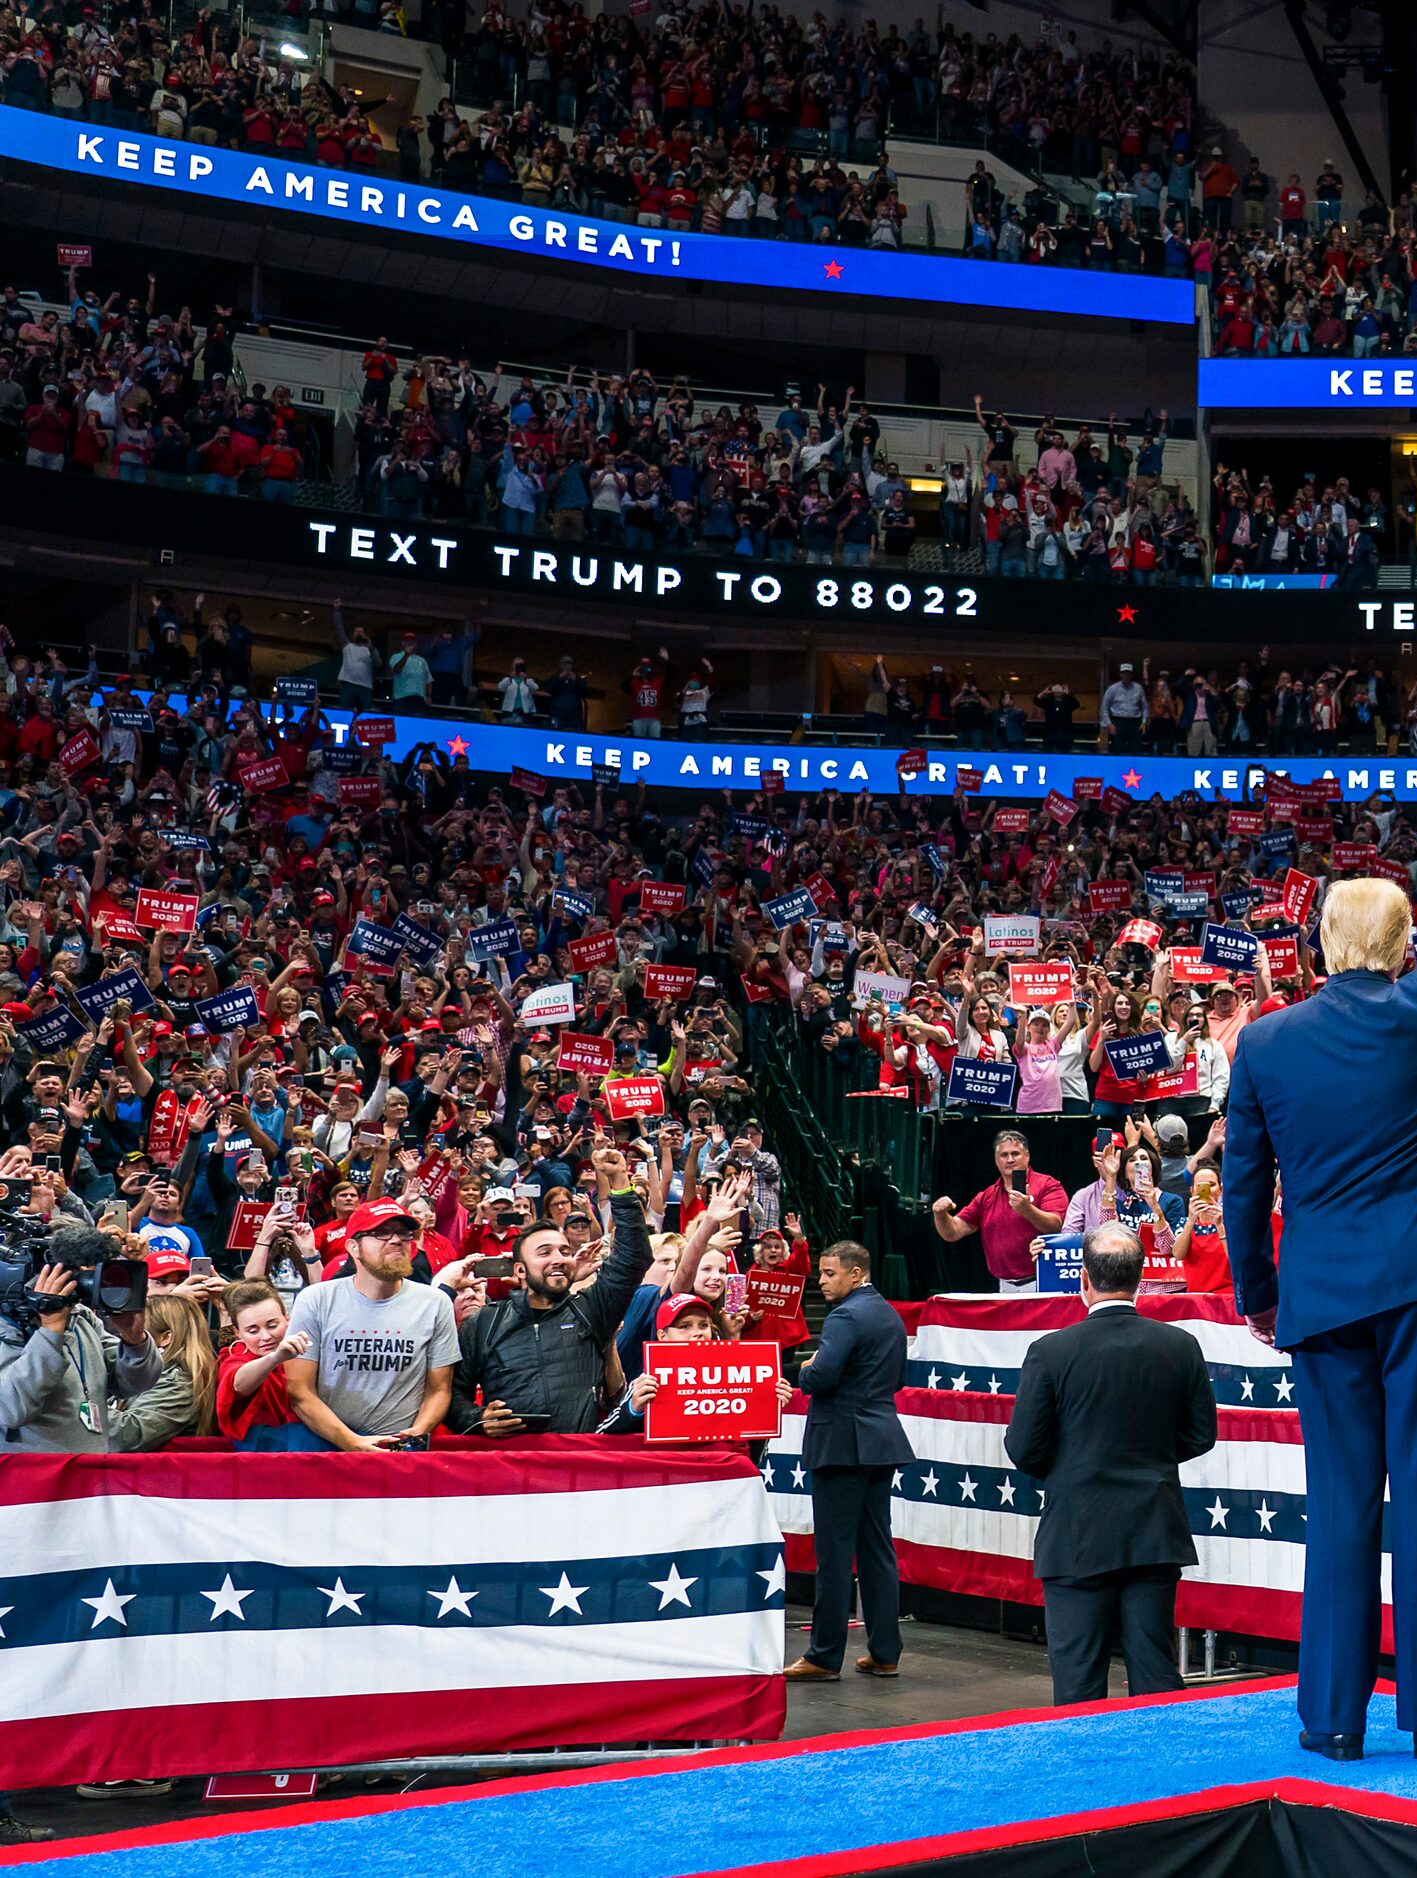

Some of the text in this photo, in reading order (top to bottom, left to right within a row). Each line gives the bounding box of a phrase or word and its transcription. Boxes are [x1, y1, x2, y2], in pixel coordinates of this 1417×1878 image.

[78, 134, 680, 265] KEEP AMERICA GREAT!
[305, 390, 321, 402] EXIT
[310, 522, 977, 616] TEXT TRUMP TO 88022
[278, 681, 315, 690] TRUMP
[636, 689, 658, 706] 45
[358, 723, 393, 734] TRUMP
[547, 743, 1046, 785] KEEP AMERICA RAT!
[1194, 769, 1287, 789] KEE
[645, 888, 682, 898] TRUMP
[141, 898, 194, 912] TRUMP
[771, 895, 811, 917] TRUMP
[1167, 896, 1206, 905] TRUMP
[784, 905, 806, 919] 2020
[1176, 904, 1197, 912] 2020
[151, 912, 180, 922] 2020
[472, 928, 515, 944] TRUMP
[988, 925, 1034, 939] Latinos
[357, 928, 402, 951] TRUMP
[990, 939, 1033, 947] FOR TRUMP
[1207, 933, 1256, 952] TRUMP
[362, 941, 387, 957] 2020
[486, 941, 509, 952] 2020
[571, 940, 614, 958] TRUMP
[584, 951, 609, 963] 2020
[1216, 949, 1245, 962] 2020
[649, 972, 693, 984] TRUMP
[1013, 973, 1069, 983] TRUMP
[1027, 986, 1058, 997] 2020
[201, 995, 258, 1019] TRUMP
[539, 1003, 568, 1015] TRUMP
[220, 1010, 250, 1027] 2020
[1110, 1041, 1162, 1059] TRUMP
[1126, 1056, 1154, 1069] 2020
[955, 1067, 1011, 1082] TRUMP
[965, 1082, 999, 1094] 2020
[1158, 1077, 1183, 1088] 2020
[609, 1086, 659, 1098] TRUMP
[625, 1099, 652, 1108] 2020
[751, 1281, 800, 1294] TRUMP
[758, 1297, 785, 1307] 2020
[334, 1338, 415, 1354] VETERANS
[347, 1354, 413, 1372] TRUMP
[655, 1366, 773, 1385] TRUMP
[684, 1398, 746, 1415] 2020
